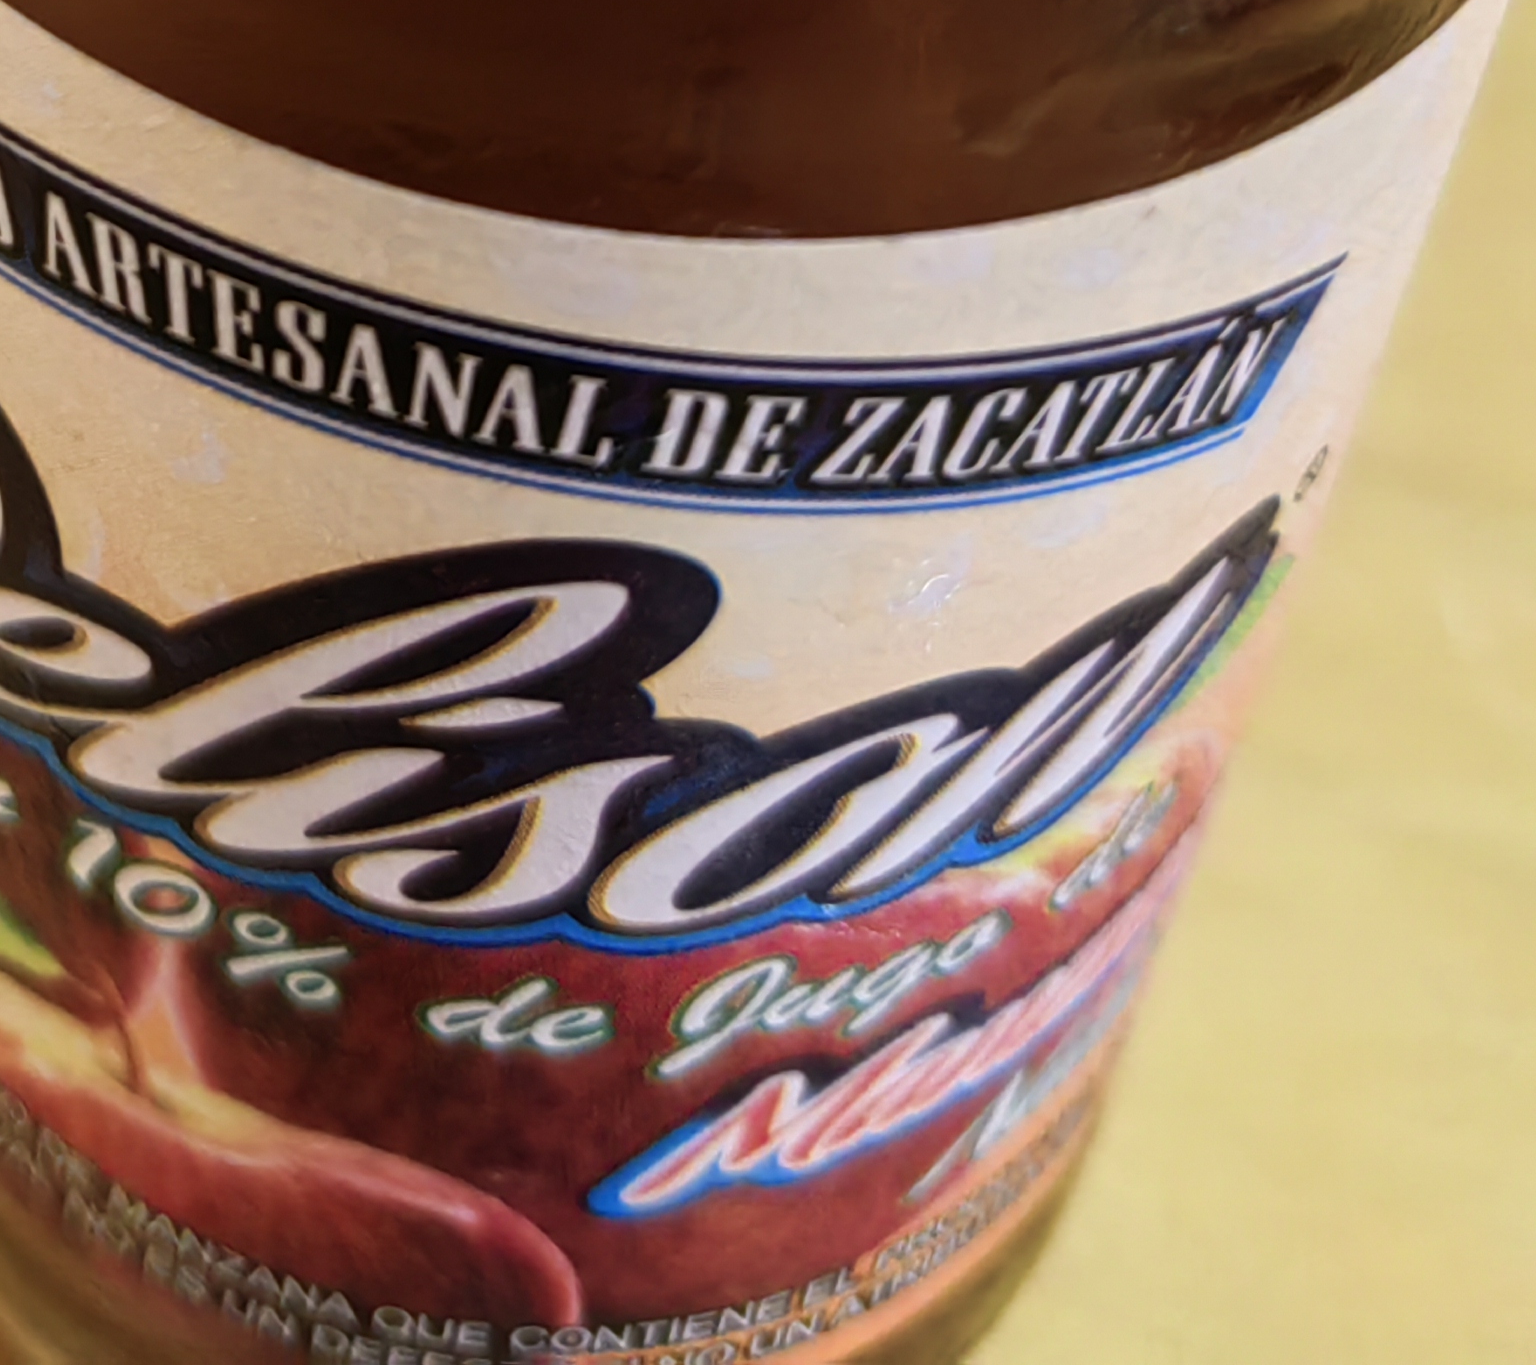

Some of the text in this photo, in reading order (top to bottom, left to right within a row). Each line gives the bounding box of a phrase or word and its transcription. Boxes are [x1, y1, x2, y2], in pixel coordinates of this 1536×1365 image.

[44, 189, 614, 470] ARTESANAL
[642, 386, 802, 482] DE
[812, 315, 1282, 482] ZACATLÁN
[67, 815, 350, 1009] 10%
[417, 977, 612, 1053] de
[649, 908, 1012, 1079] Jugo
[107, 1181, 363, 1333] MANZANA
[371, 1304, 491, 1355] QUE
[510, 1291, 792, 1361] CONTIENE
[802, 1267, 856, 1311] EL
